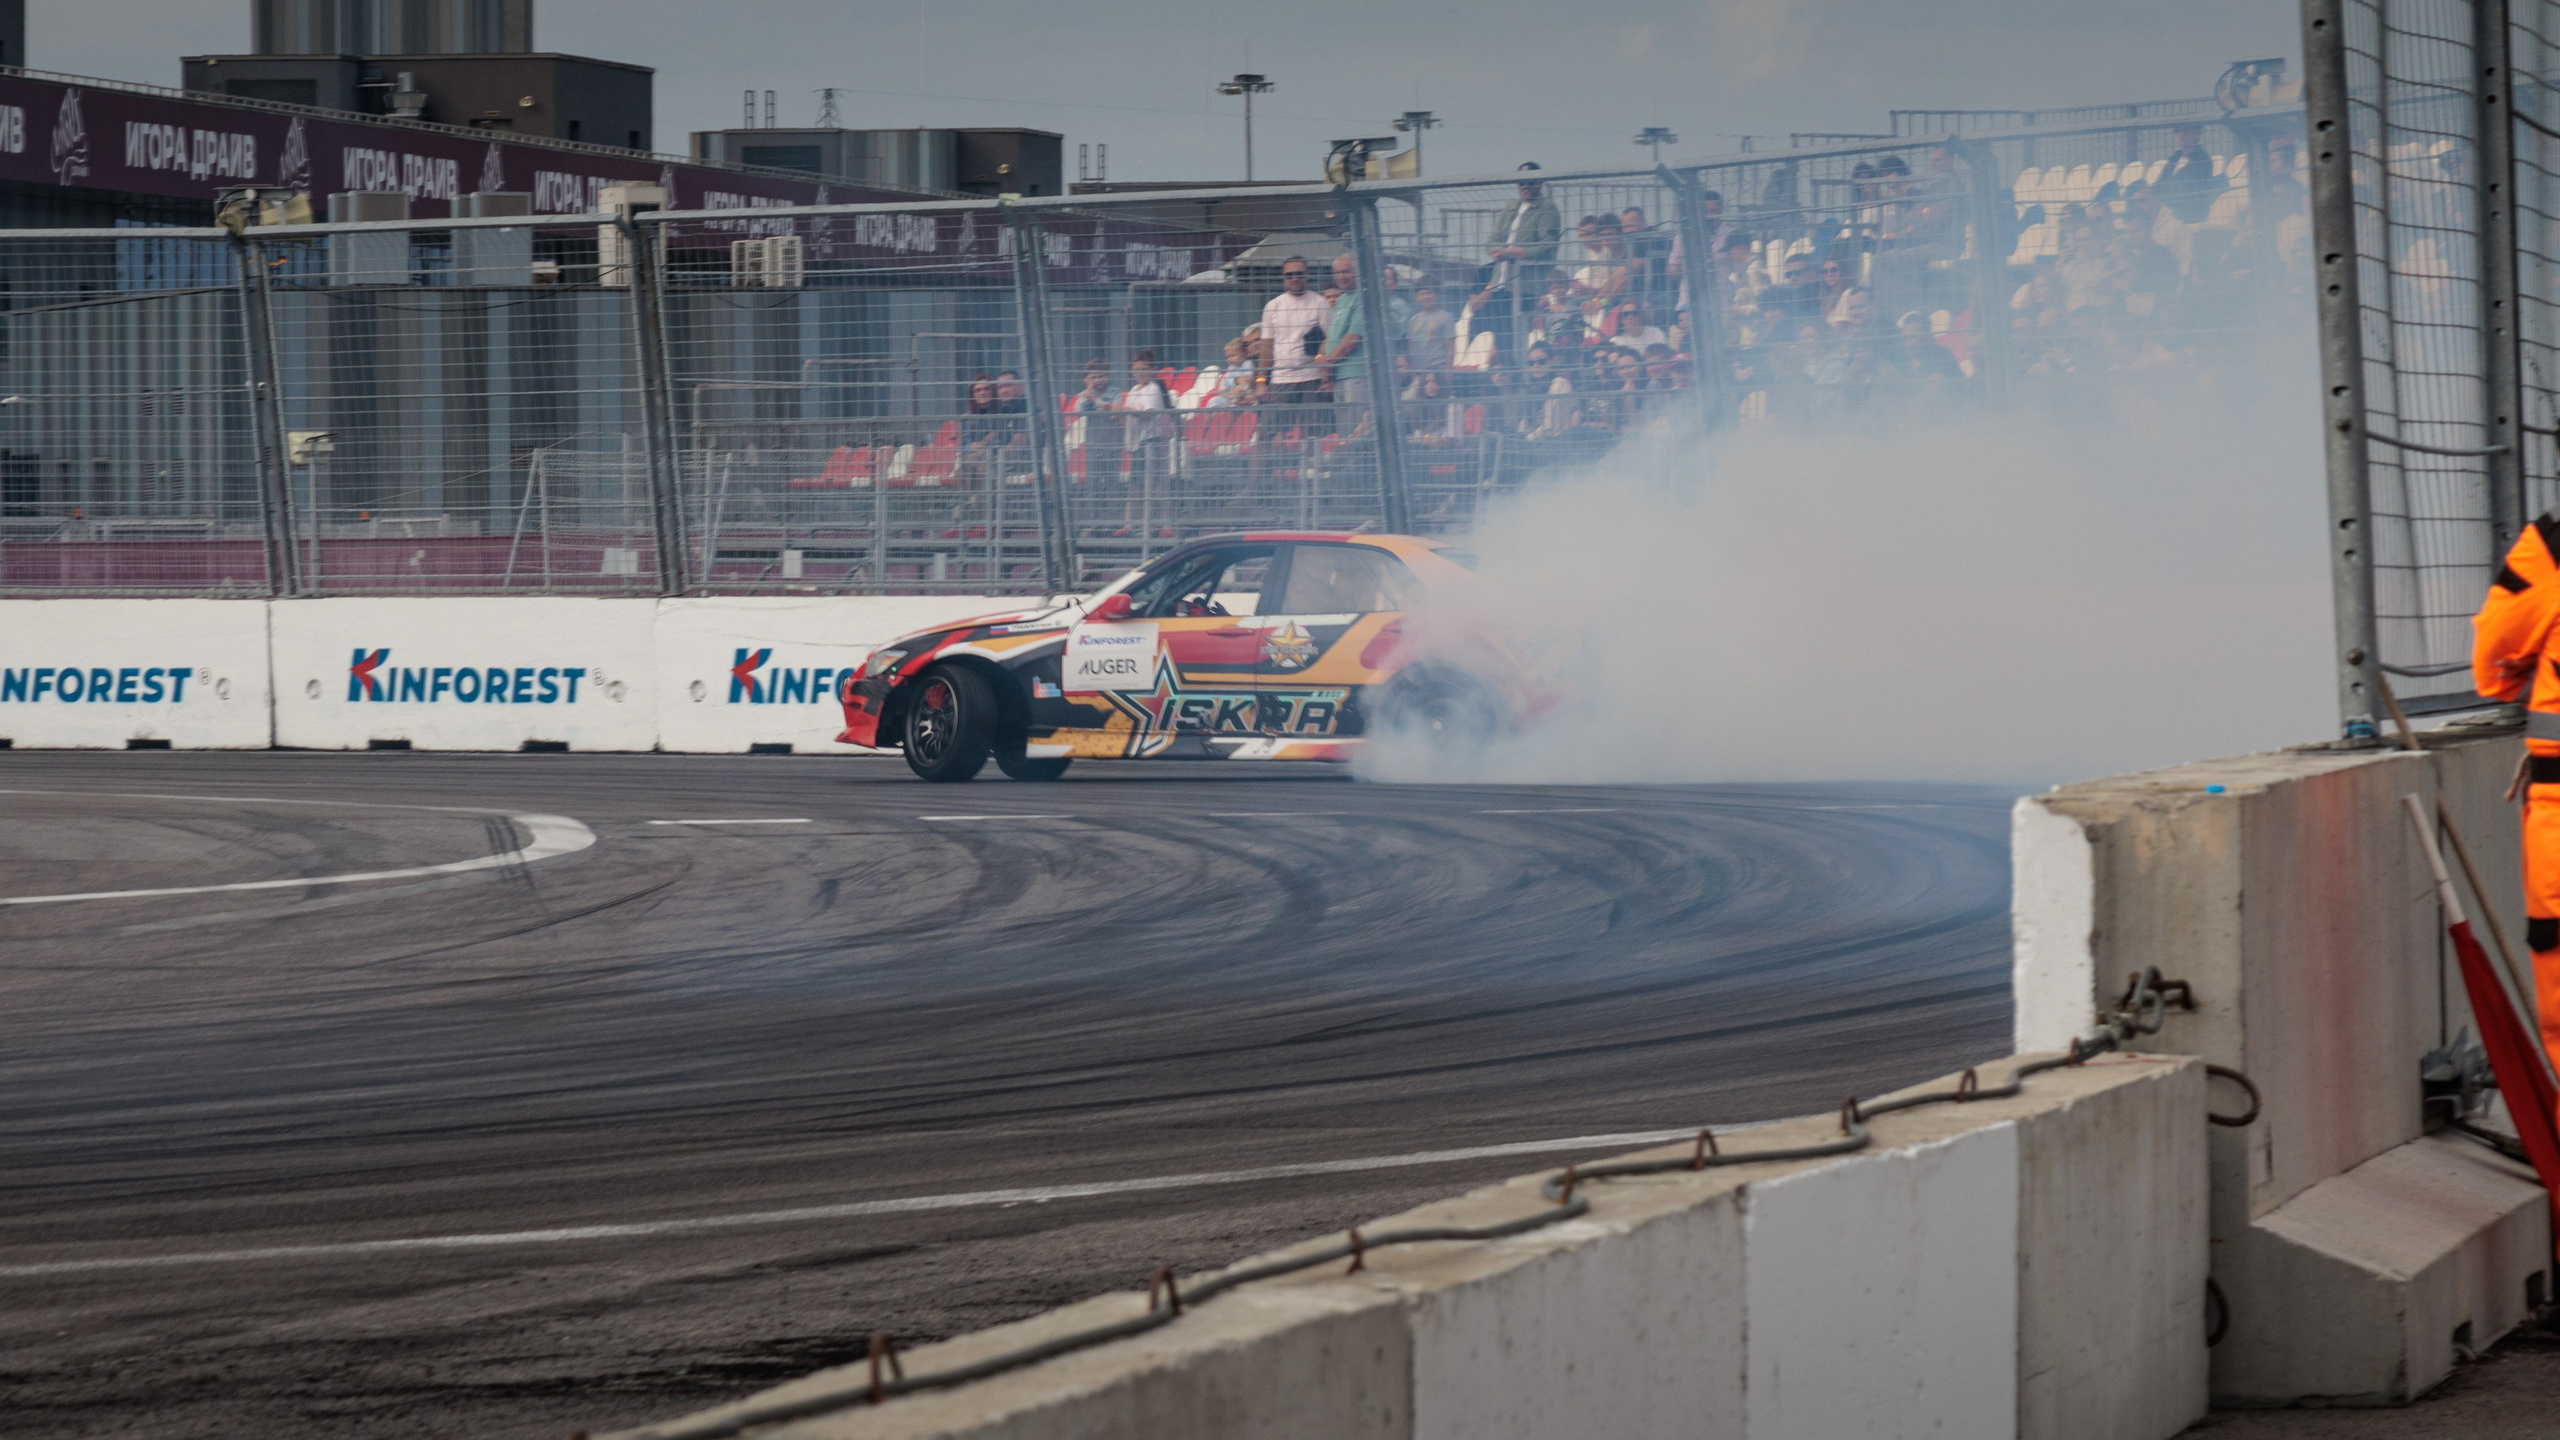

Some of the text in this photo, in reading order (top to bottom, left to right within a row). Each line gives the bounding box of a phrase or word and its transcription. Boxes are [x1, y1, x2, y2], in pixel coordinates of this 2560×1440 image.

[125, 120, 190, 172] ИГОРА
[343, 146, 399, 192] ИГОРА
[534, 170, 585, 214] ИГОРА
[346, 648, 586, 703] KINFOREST
[1078, 659, 1138, 676] AUGER
[1156, 696, 1340, 733] ISKRA
